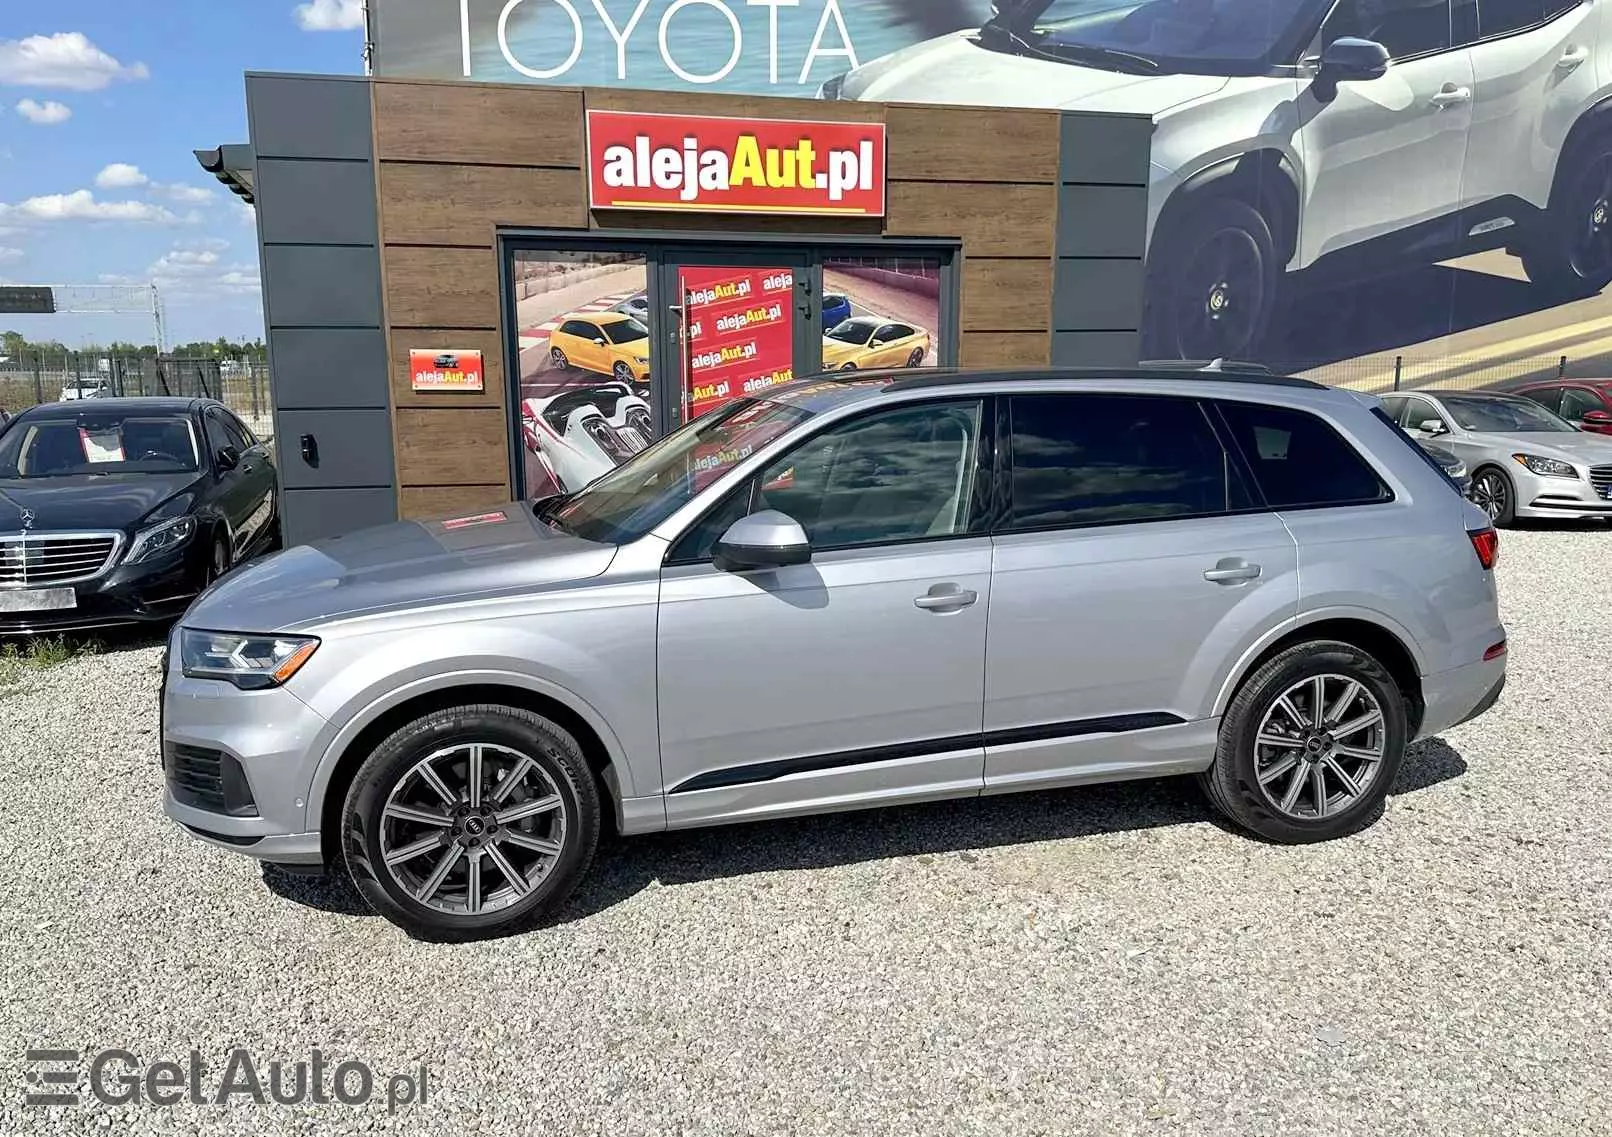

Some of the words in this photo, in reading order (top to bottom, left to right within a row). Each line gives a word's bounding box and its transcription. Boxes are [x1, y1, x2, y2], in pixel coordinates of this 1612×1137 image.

[459, 0, 860, 84] TOYOTA
[603, 135, 873, 200] alejaAut.pl
[716, 303, 782, 330] alejaAut.pl
[692, 342, 757, 368] alejaAut.pl
[415, 371, 479, 384] alejaAut.pl
